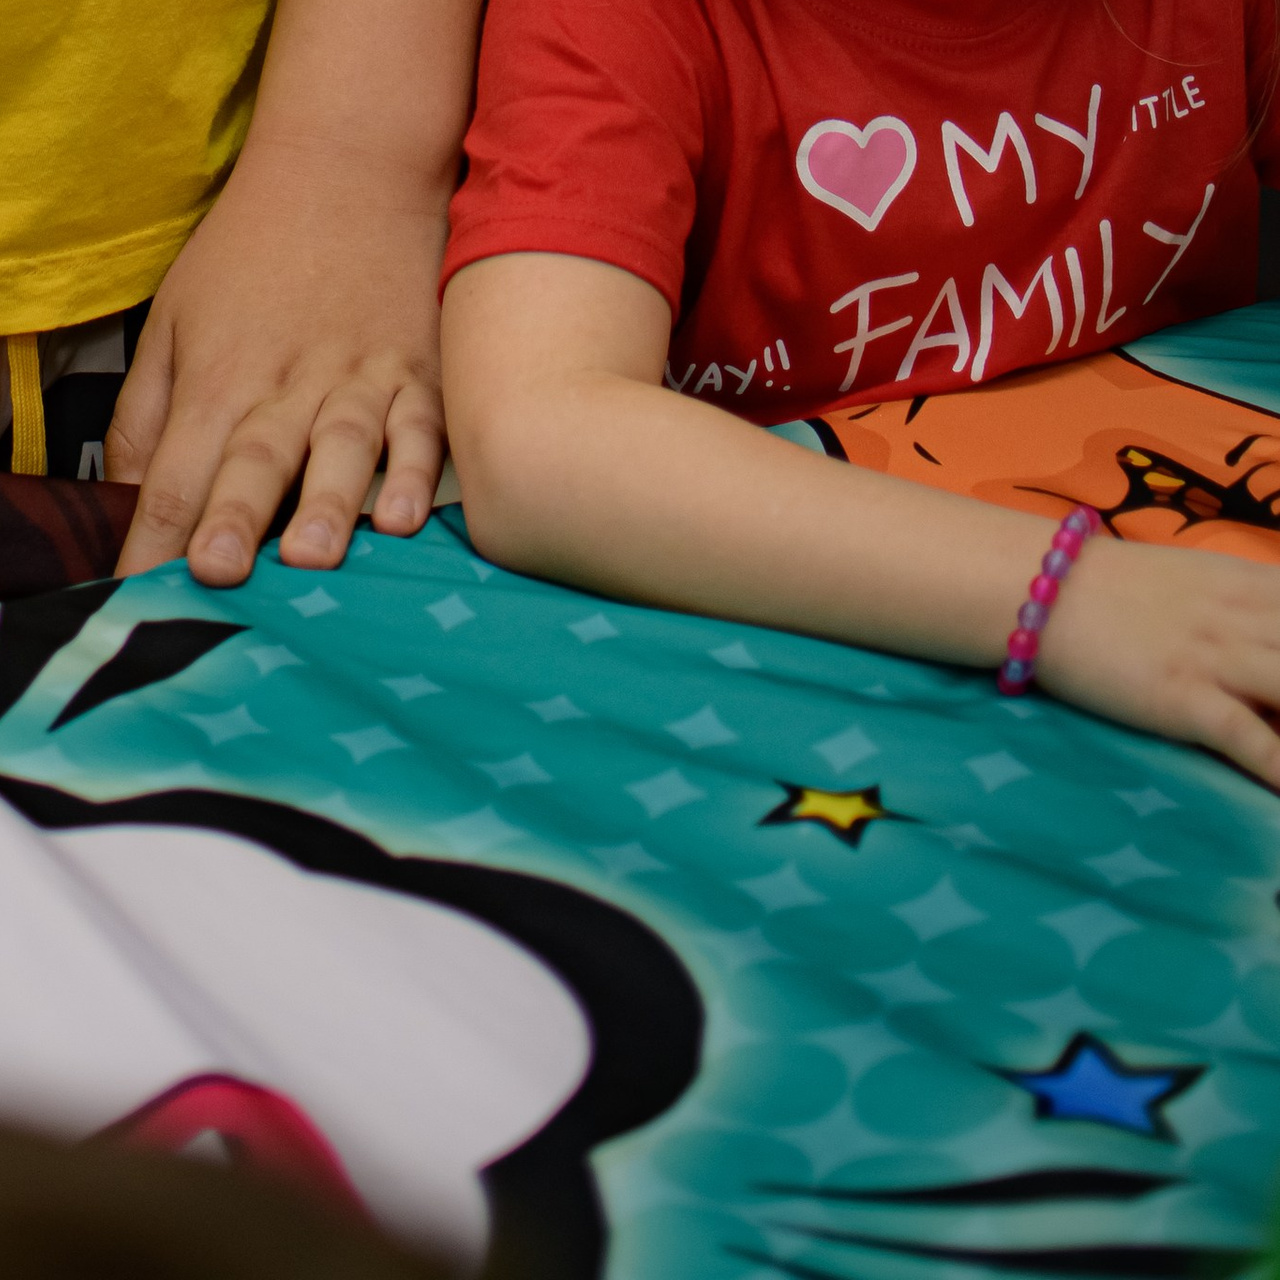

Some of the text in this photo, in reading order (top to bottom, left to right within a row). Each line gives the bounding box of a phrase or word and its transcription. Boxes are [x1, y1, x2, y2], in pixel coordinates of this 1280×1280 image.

[941, 74, 1206, 227] MY ITTLE
[829, 183, 1215, 392] FAMILY
